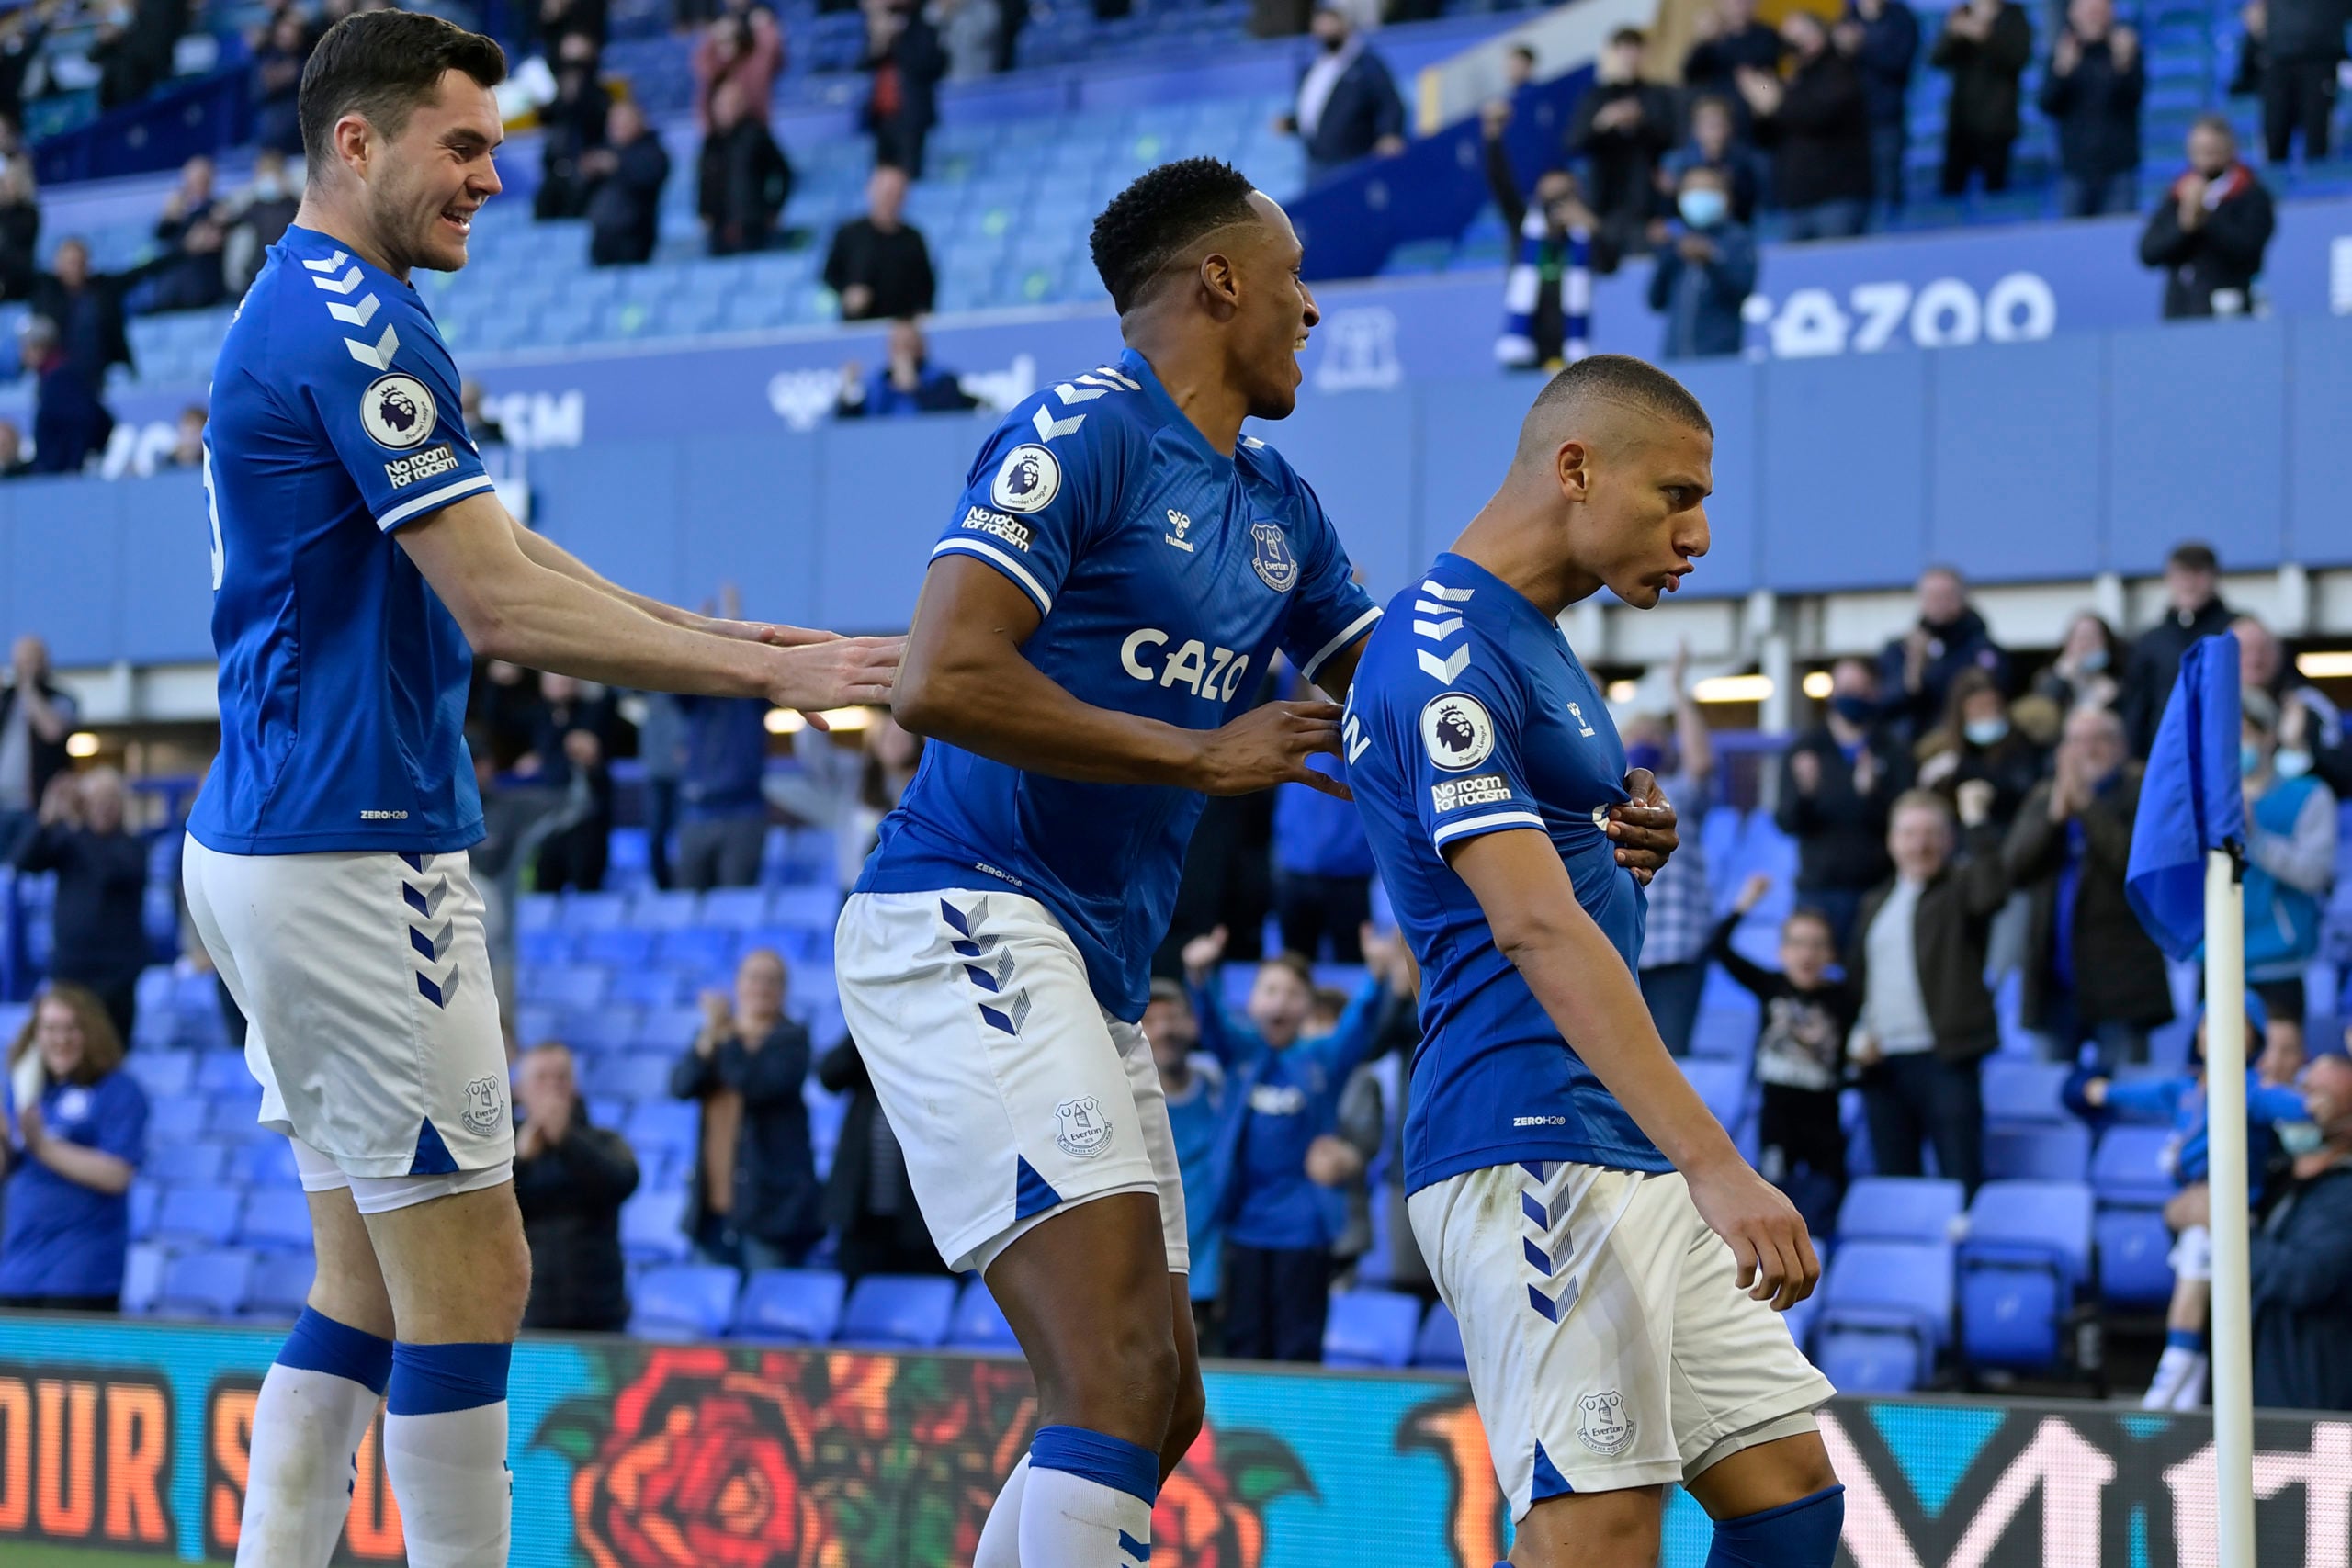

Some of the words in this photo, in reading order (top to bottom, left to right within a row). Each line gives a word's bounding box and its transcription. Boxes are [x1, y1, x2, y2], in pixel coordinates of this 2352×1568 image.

[384, 460, 410, 476] No
[409, 446, 449, 468] room
[390, 470, 413, 490] for
[413, 457, 458, 479] racism
[967, 505, 990, 522] No
[990, 513, 1030, 540] room
[981, 524, 1030, 554] racism
[1165, 532, 1194, 553] hummel
[1264, 560, 1289, 571] Everton
[1458, 749, 1480, 762] Premier
[1430, 783, 1457, 799] No
[1456, 775, 1502, 794] room
[1434, 795, 1457, 814] for
[1457, 787, 1512, 807] racism
[475, 1107, 499, 1119] Everton
[1070, 1127, 1102, 1142] Everton
[1591, 1426, 1623, 1437] Everton
